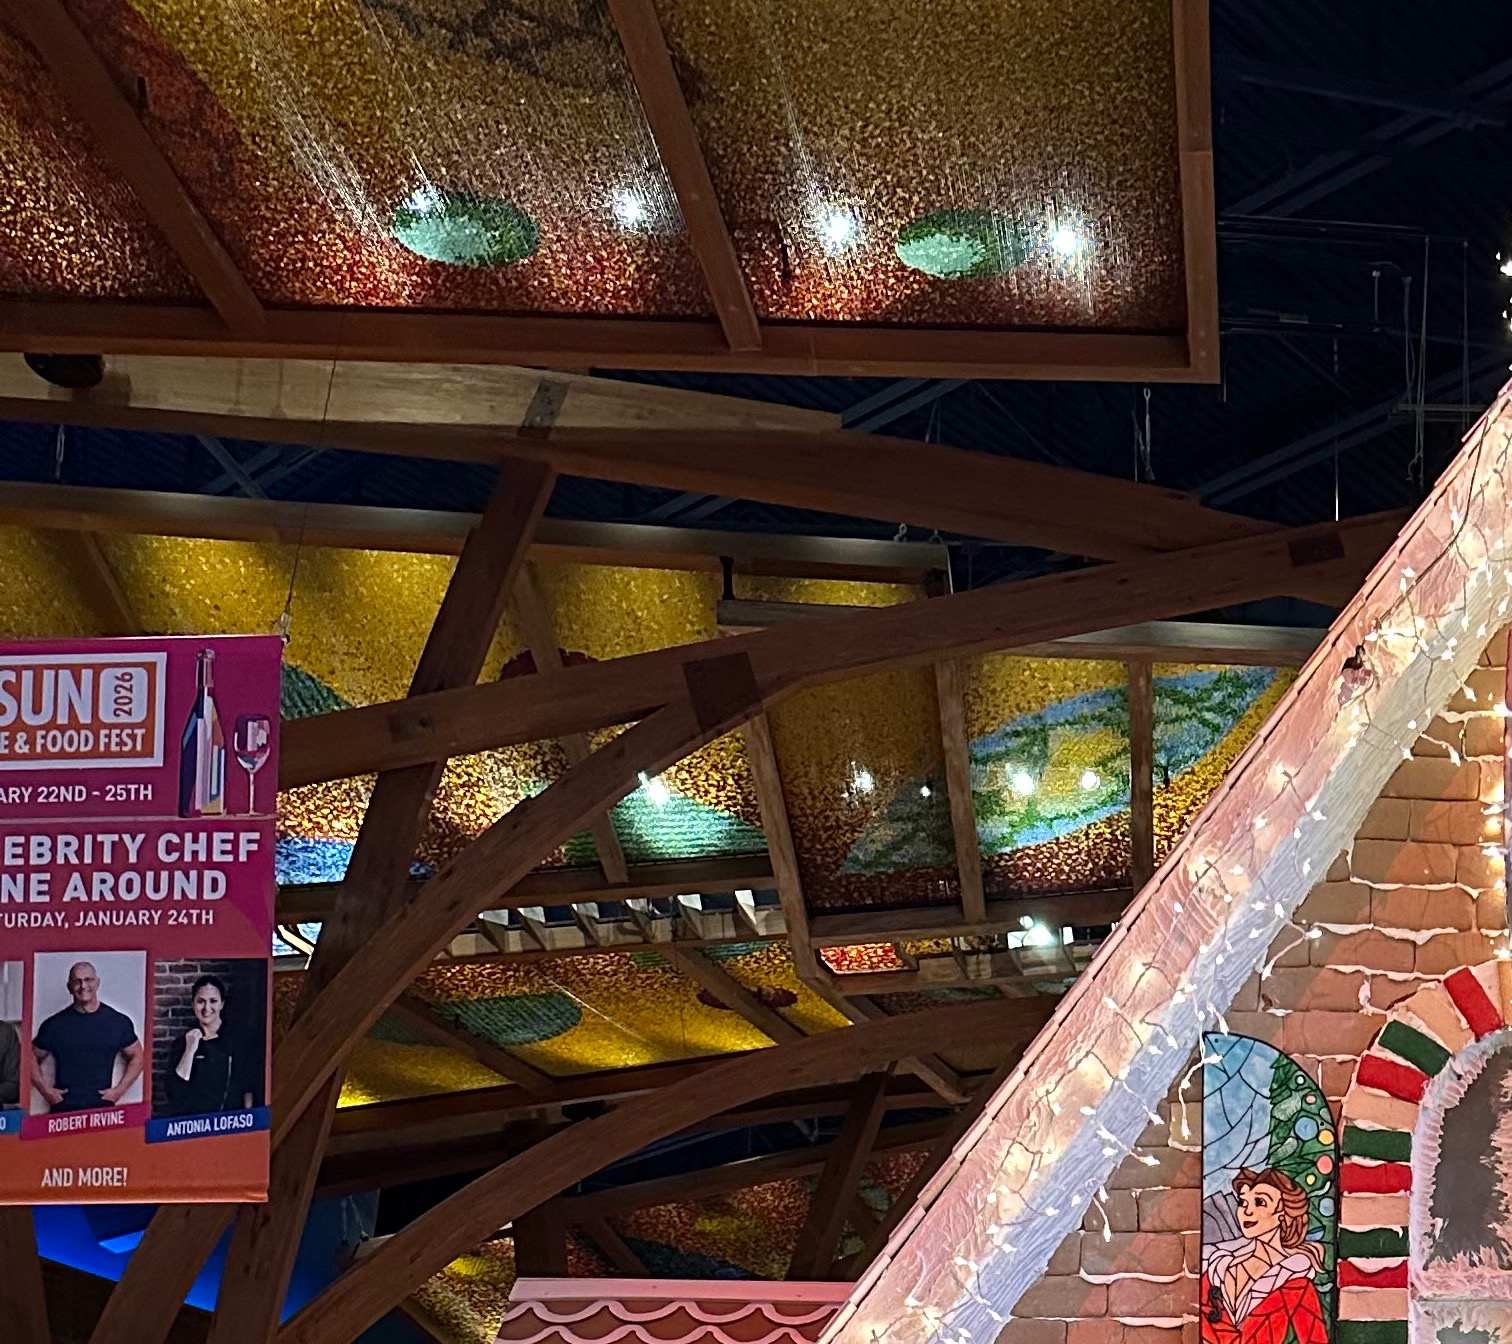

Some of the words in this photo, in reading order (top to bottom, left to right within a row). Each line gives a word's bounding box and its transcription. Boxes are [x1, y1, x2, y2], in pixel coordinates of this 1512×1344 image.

[114, 671, 133, 717] 2026
[15, 731, 29, 752] &
[36, 730, 94, 752] FOOD
[100, 728, 145, 752] FEST
[37, 786, 87, 803] 22ND
[105, 784, 152, 801] 25TH
[158, 832, 260, 863] CHEF
[63, 870, 227, 902] AROUND
[75, 910, 162, 926] JANUARY
[168, 909, 214, 924] 24TH
[48, 1114, 88, 1133] ROBERT
[90, 1110, 125, 1130] IRVINE
[167, 1116, 211, 1137] ANTONIA
[214, 1114, 253, 1131] LOFASO
[42, 1168, 73, 1187] AND
[78, 1167, 128, 1186] MORE!
